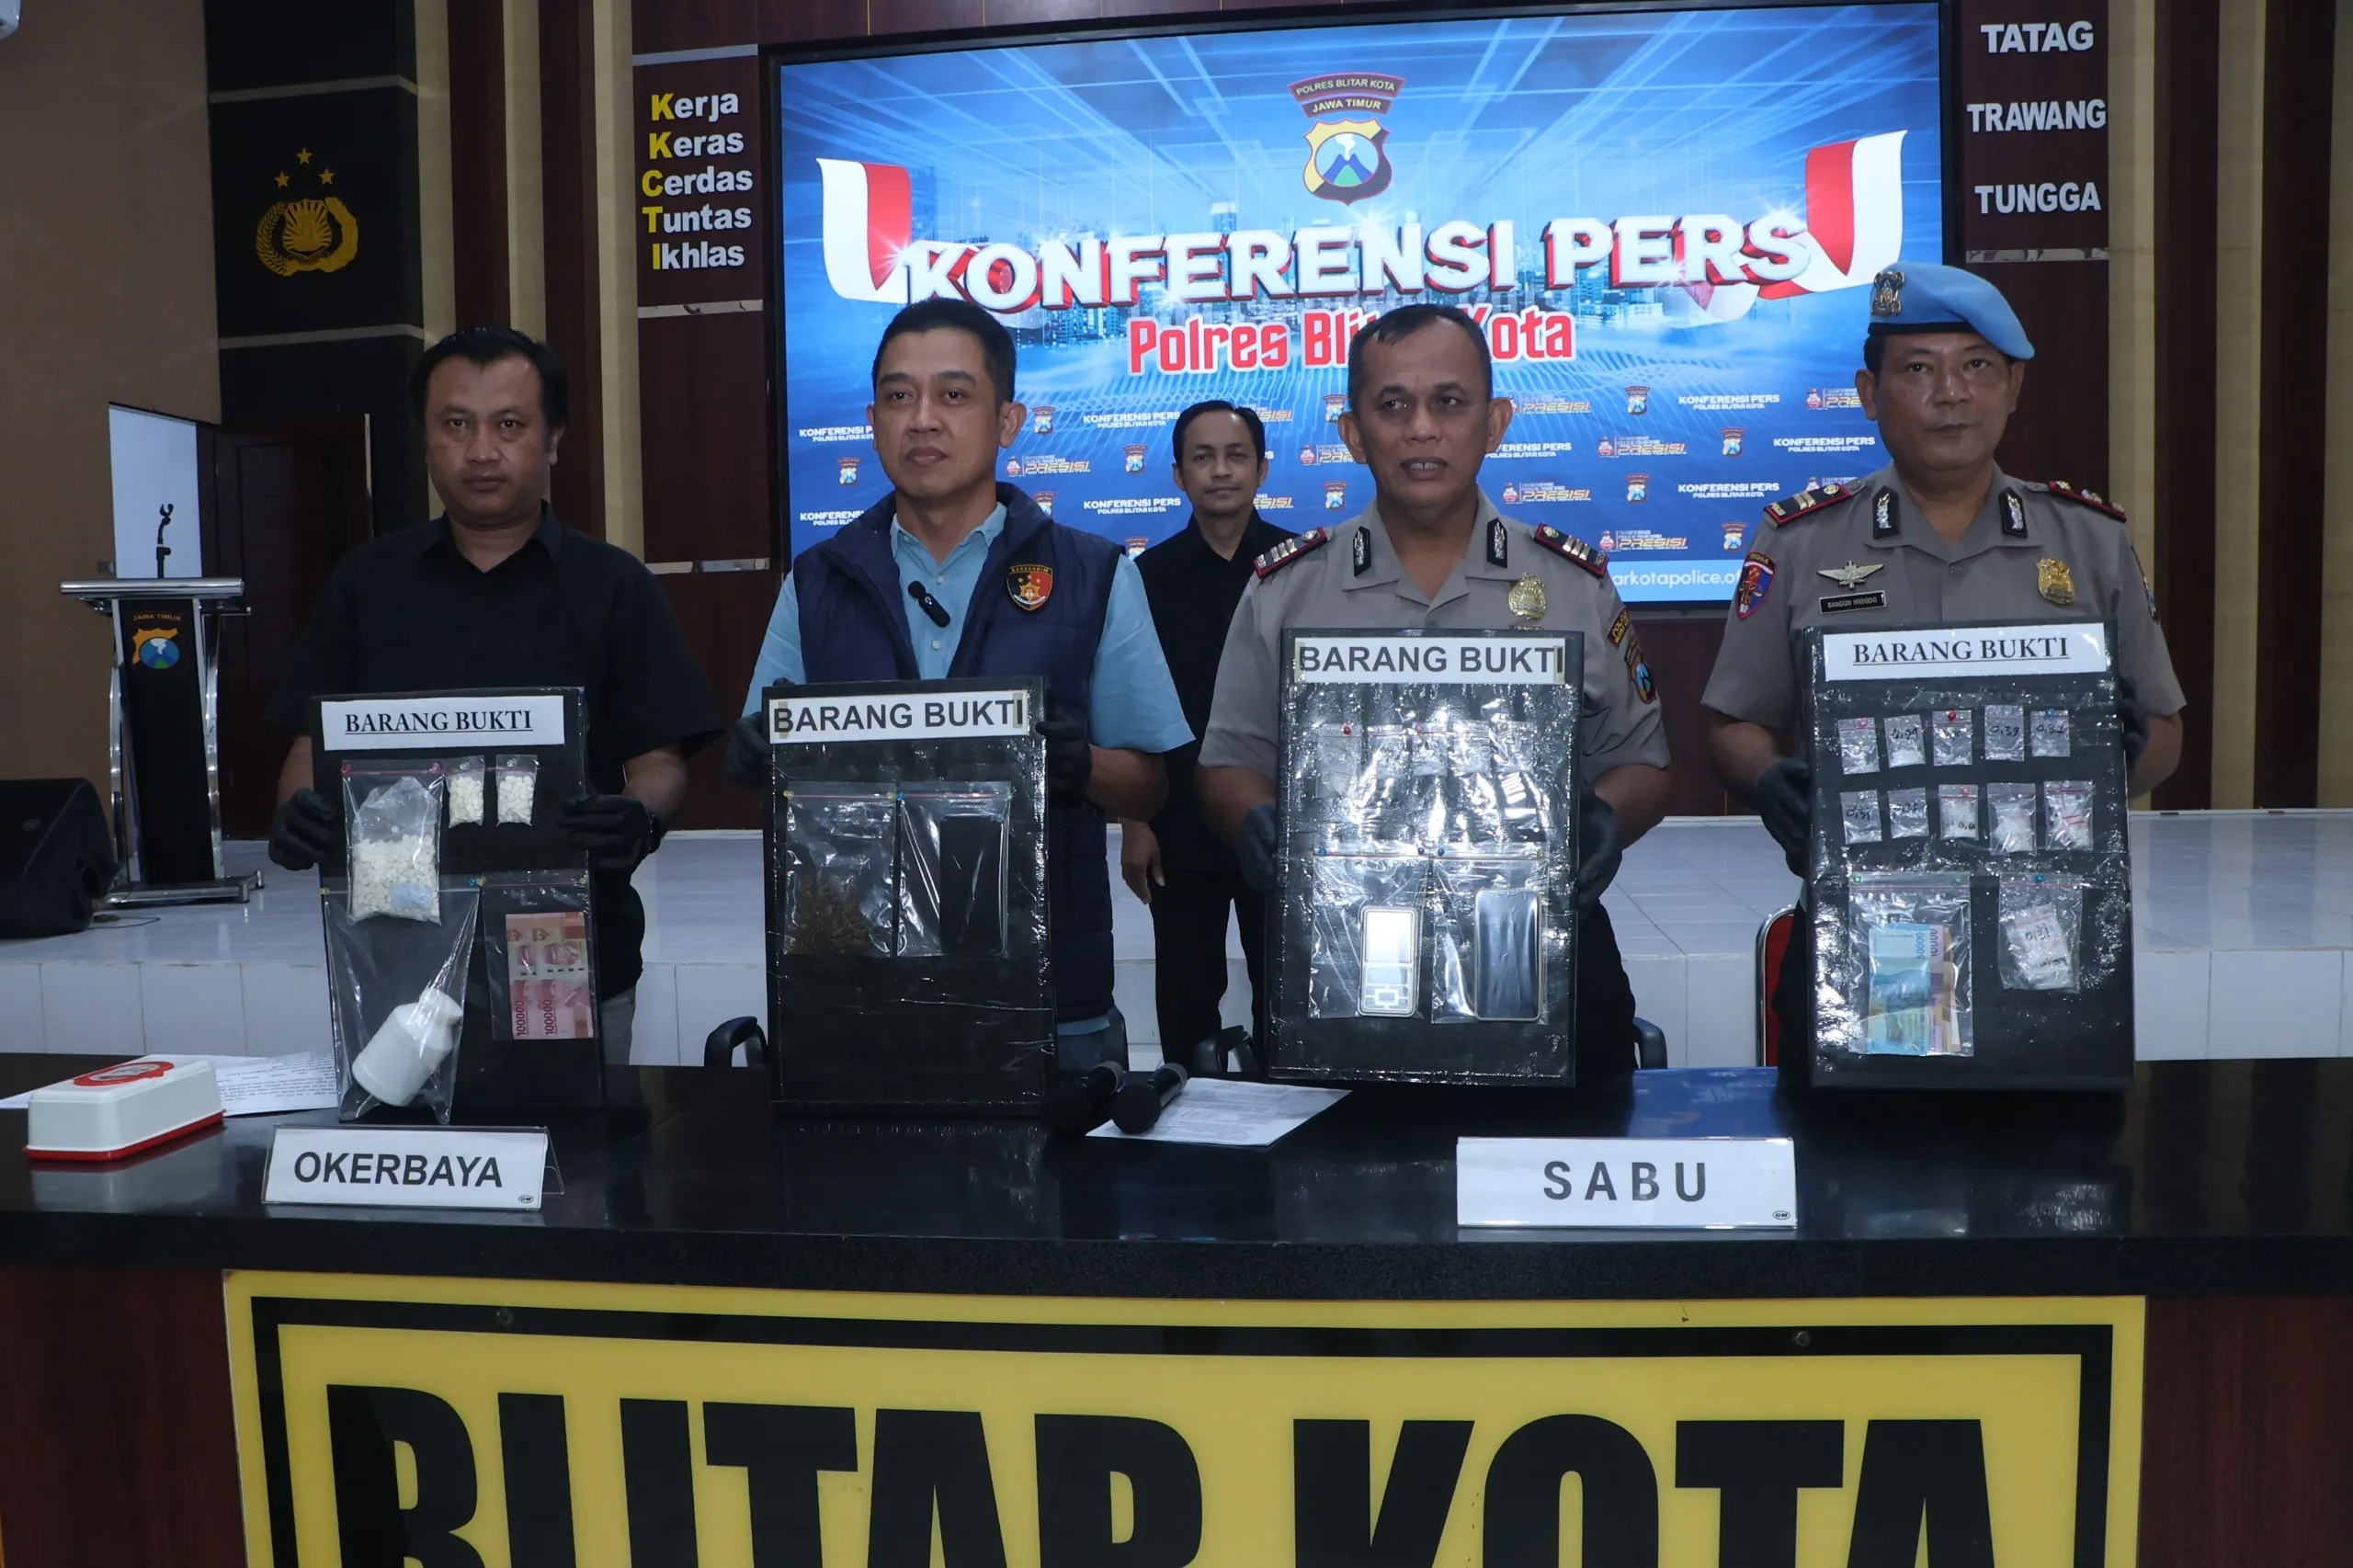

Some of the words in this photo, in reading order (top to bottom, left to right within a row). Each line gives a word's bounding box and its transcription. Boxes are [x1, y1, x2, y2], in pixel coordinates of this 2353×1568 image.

[1980, 20, 2095, 54] TATAG
[1296, 80, 1334, 96] POLRES
[1336, 78, 1368, 87] BLITAR
[1370, 79, 1395, 91] KOTA
[652, 93, 739, 122] Kerja
[1313, 99, 1344, 113] JAWA
[1346, 98, 1381, 109] TIMUR
[1967, 98, 2107, 132] TRAWANG
[649, 131, 745, 160] Keras
[642, 165, 754, 197] Cerdas
[1974, 182, 2101, 214] TUNGGA
[642, 203, 752, 233] Tuntas
[652, 241, 745, 269] Ikhlas
[904, 220, 1515, 313] KONFERENSI
[1545, 213, 1813, 290] PERS
[1129, 316, 1289, 375] Polres
[1678, 395, 1749, 404] KONFERENSI
[1751, 394, 1780, 403] PERS
[800, 426, 864, 437] KONFERENSI
[1084, 413, 1151, 424] KONFERENSI
[1154, 412, 1180, 420] PERS
[1543, 442, 1572, 451] PERS
[1618, 443, 1686, 454] PRESISI
[1774, 437, 1844, 447] KONFERENSI
[1846, 437, 1875, 446] PERS
[1026, 461, 1089, 472] PRESISI
[1523, 490, 1590, 500] PRESISI
[1678, 483, 1748, 493] KONFERENSI
[1750, 483, 1779, 491] PERS
[1084, 499, 1151, 509] KONFERENSI
[1153, 497, 1181, 506] PERS
[1619, 538, 1687, 548] PRESISI
[132, 613, 155, 621] JAWA
[157, 613, 182, 622] TIMUR
[1299, 645, 1448, 673] BARANG
[1460, 646, 1563, 674] BUKTI
[1853, 640, 1973, 664] BARANG
[1980, 636, 2070, 660] BUKTI
[346, 711, 449, 733] BARANG
[455, 710, 532, 731] BUKTI
[773, 701, 914, 733] BARANG
[924, 699, 1024, 728] BUKTI
[1915, 932, 1926, 960] 50000
[515, 1000, 526, 1036] 100000
[543, 999, 554, 1035] 100000
[293, 1151, 504, 1188] OKERBAYA
[1543, 1160, 1707, 1203] SABU
